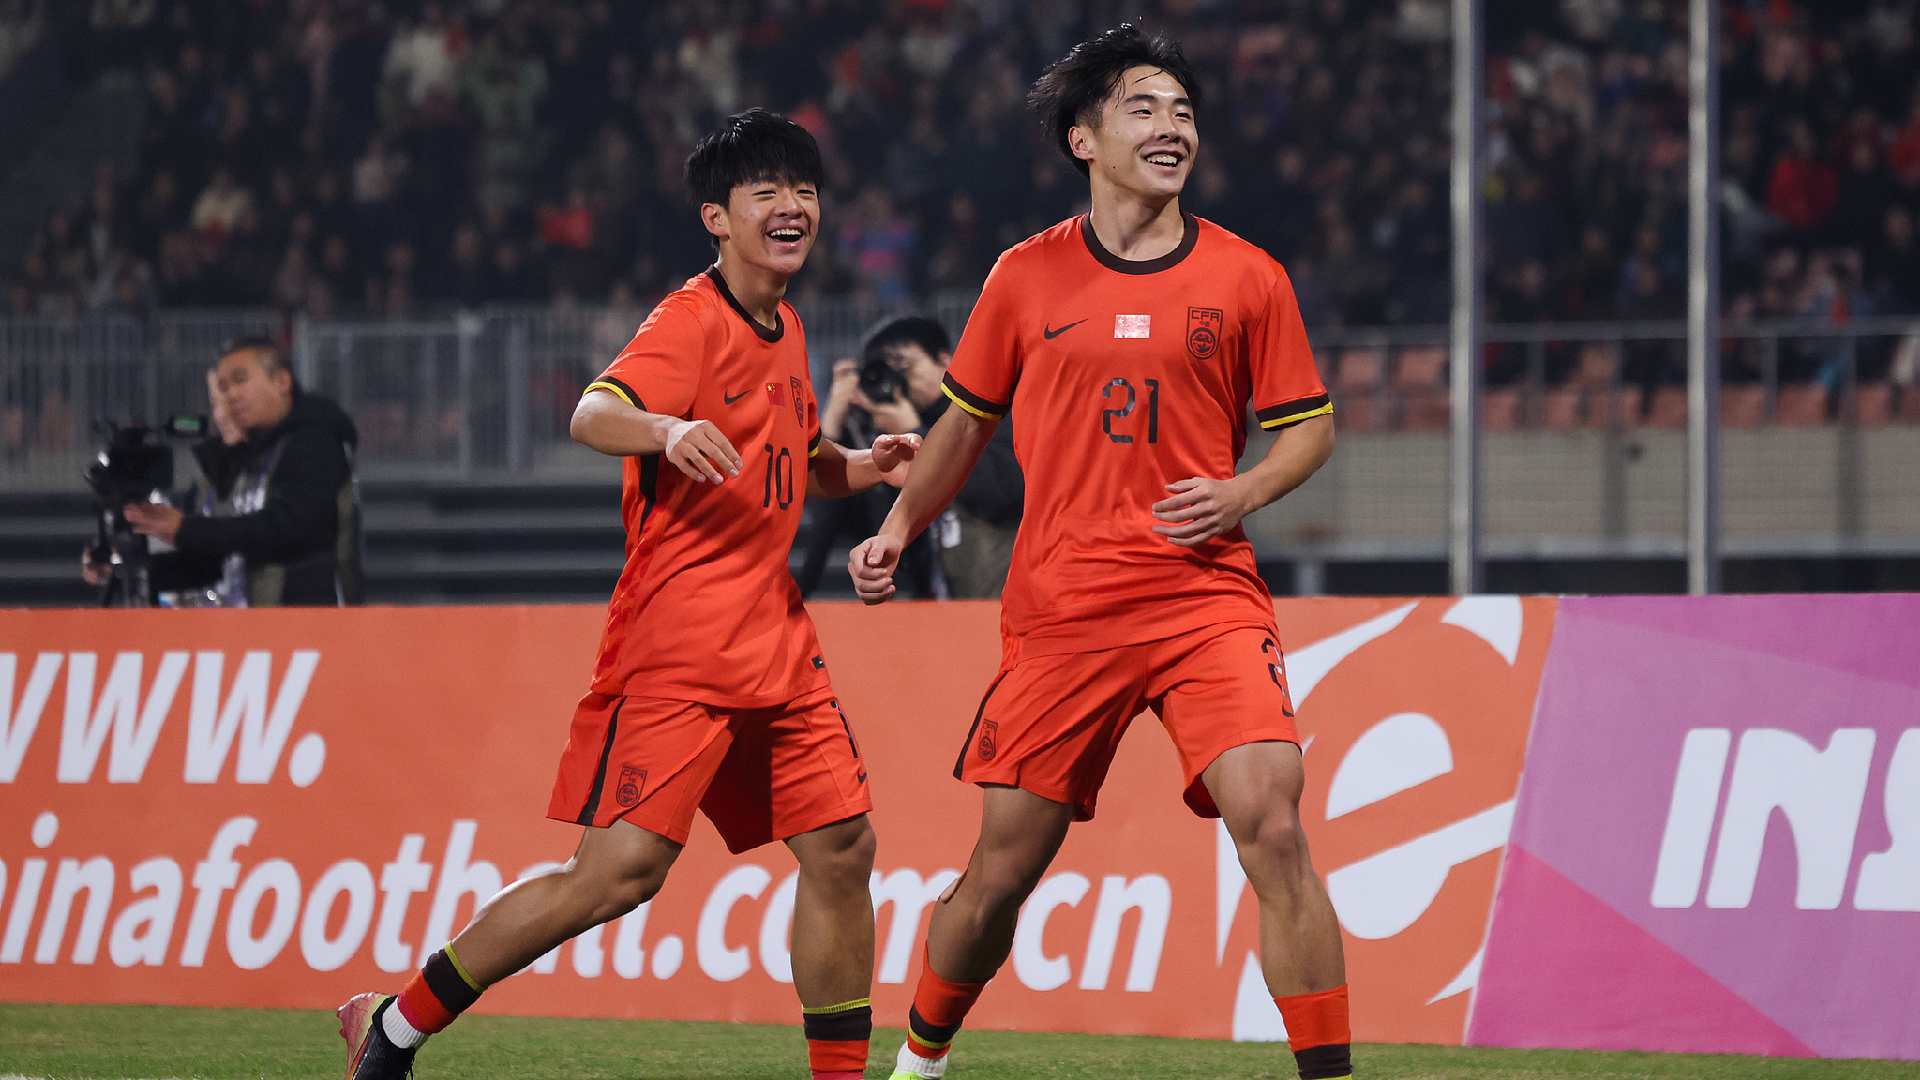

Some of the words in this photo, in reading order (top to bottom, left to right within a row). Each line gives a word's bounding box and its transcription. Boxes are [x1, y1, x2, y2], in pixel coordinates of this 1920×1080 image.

[1191, 309, 1220, 322] CFA
[1102, 377, 1159, 444] 21
[763, 443, 793, 510] 10
